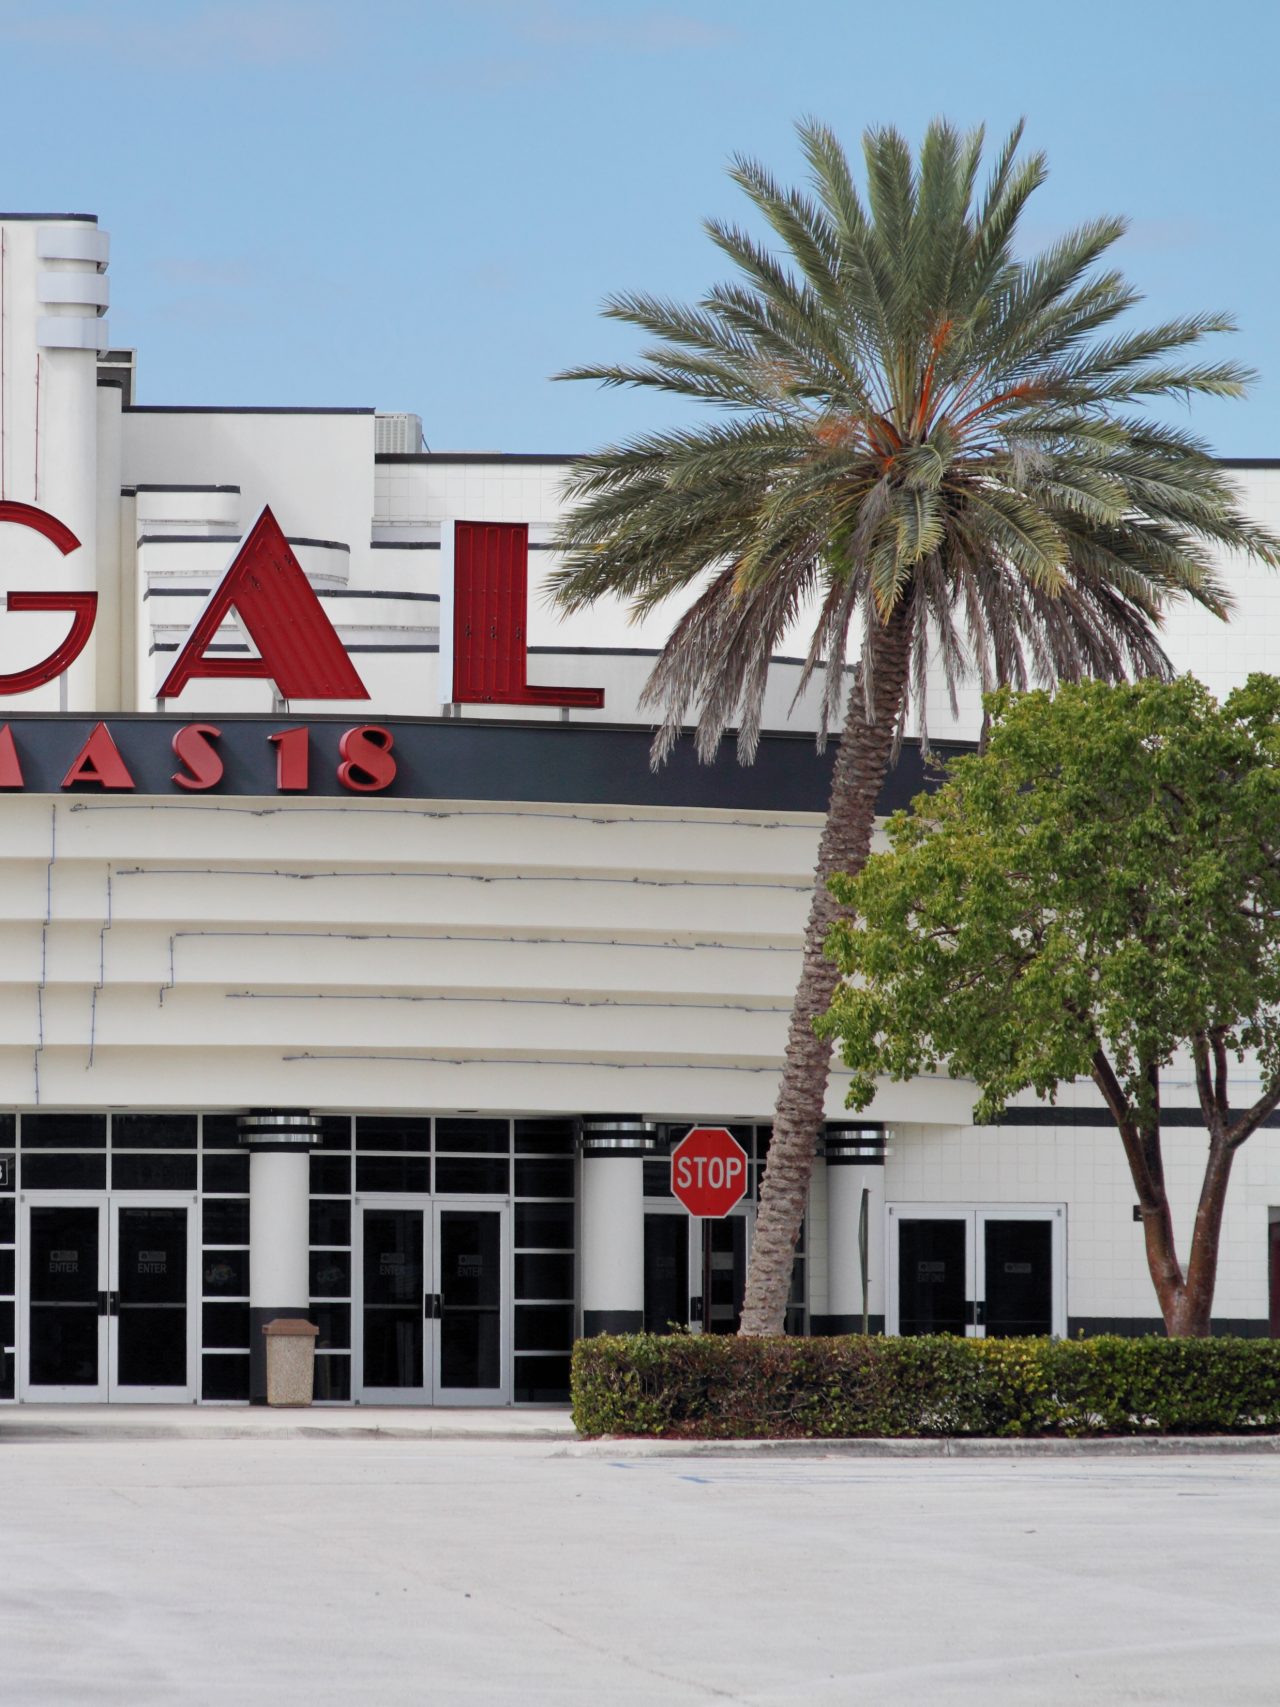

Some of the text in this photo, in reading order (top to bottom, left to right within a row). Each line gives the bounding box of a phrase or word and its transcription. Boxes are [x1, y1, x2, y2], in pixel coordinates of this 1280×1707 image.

[267, 724, 397, 791] 18
[677, 1156, 742, 1189] STOP
[49, 1262, 79, 1273] ENTER
[137, 1263, 167, 1273] ENTER
